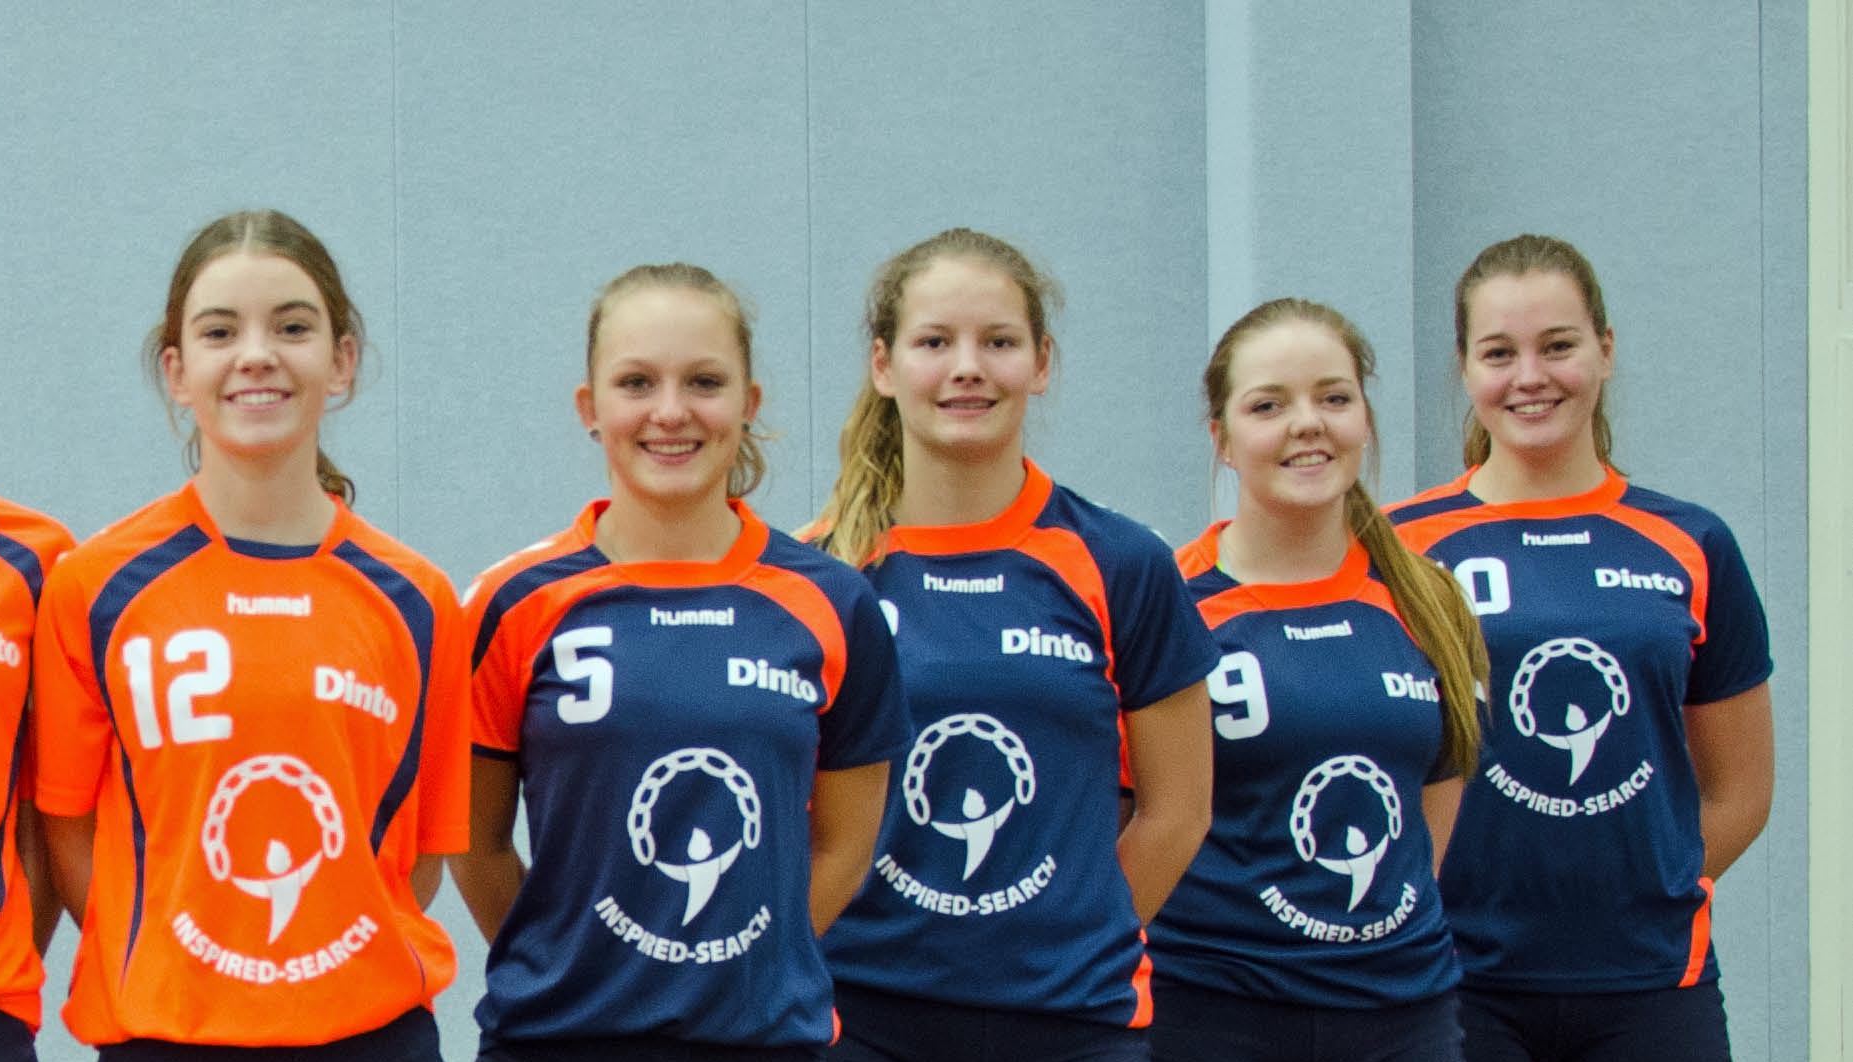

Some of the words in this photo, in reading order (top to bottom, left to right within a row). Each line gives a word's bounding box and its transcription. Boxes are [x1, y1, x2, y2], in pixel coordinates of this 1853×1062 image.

[1522, 530, 1590, 546] hummel
[227, 592, 311, 616] hummel
[923, 573, 1004, 593] hummel
[1595, 567, 1684, 596] Dinto
[650, 607, 735, 626] hummel
[1283, 620, 1352, 641] hummel
[1001, 627, 1093, 663] Dinto
[122, 628, 233, 749] 12
[314, 665, 398, 725] Dinto
[552, 626, 614, 724] 5
[727, 657, 818, 703] Dinto
[1207, 651, 1269, 740] 9
[1485, 760, 1655, 818] INSPIRED-SEARCH
[875, 853, 1058, 916] INSPIRED-SEARCH
[1259, 884, 1417, 943] INSPIRED-SEARCH
[172, 911, 379, 984] INSPIRED-SEARCH
